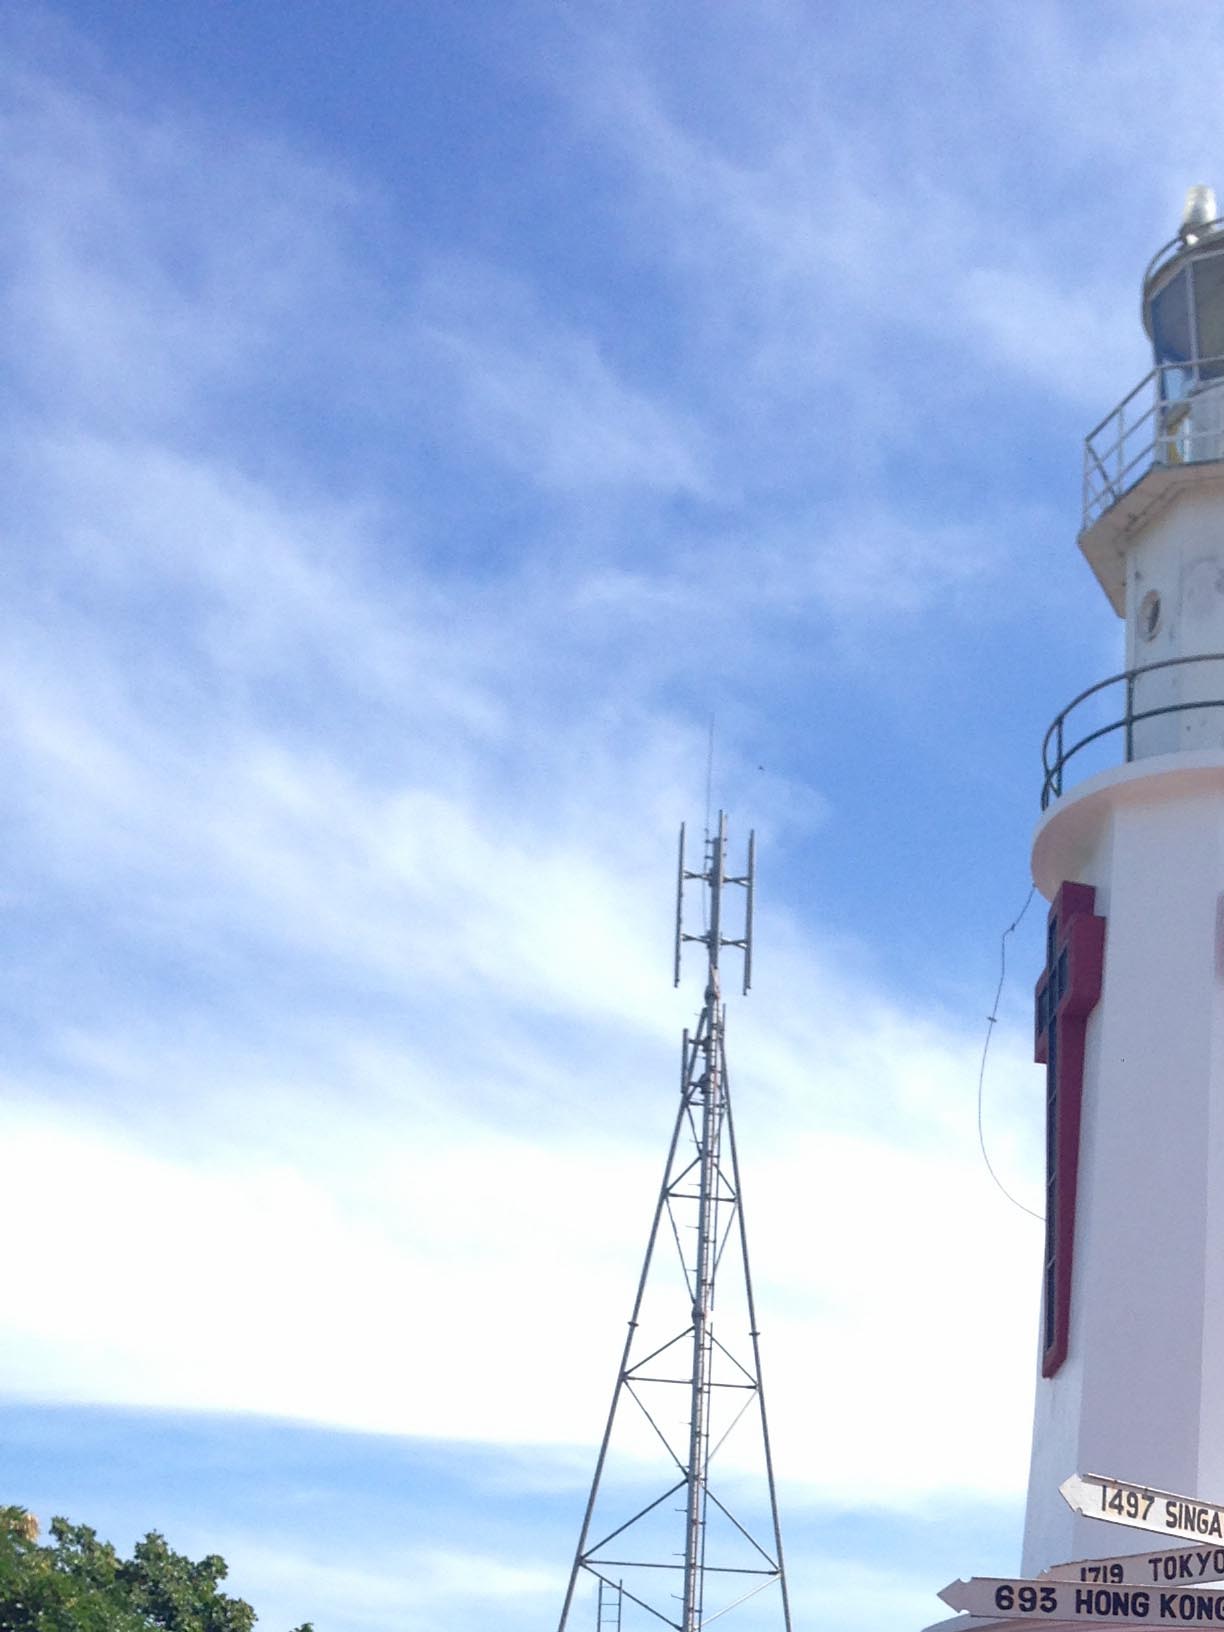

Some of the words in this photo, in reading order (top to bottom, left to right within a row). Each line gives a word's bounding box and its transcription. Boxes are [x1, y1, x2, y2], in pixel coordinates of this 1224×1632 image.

[1100, 1485, 1155, 1521] 1497
[1080, 1564, 1124, 1584] 1719
[994, 1584, 1058, 1613] 693
[1075, 1588, 1149, 1617] HONG
